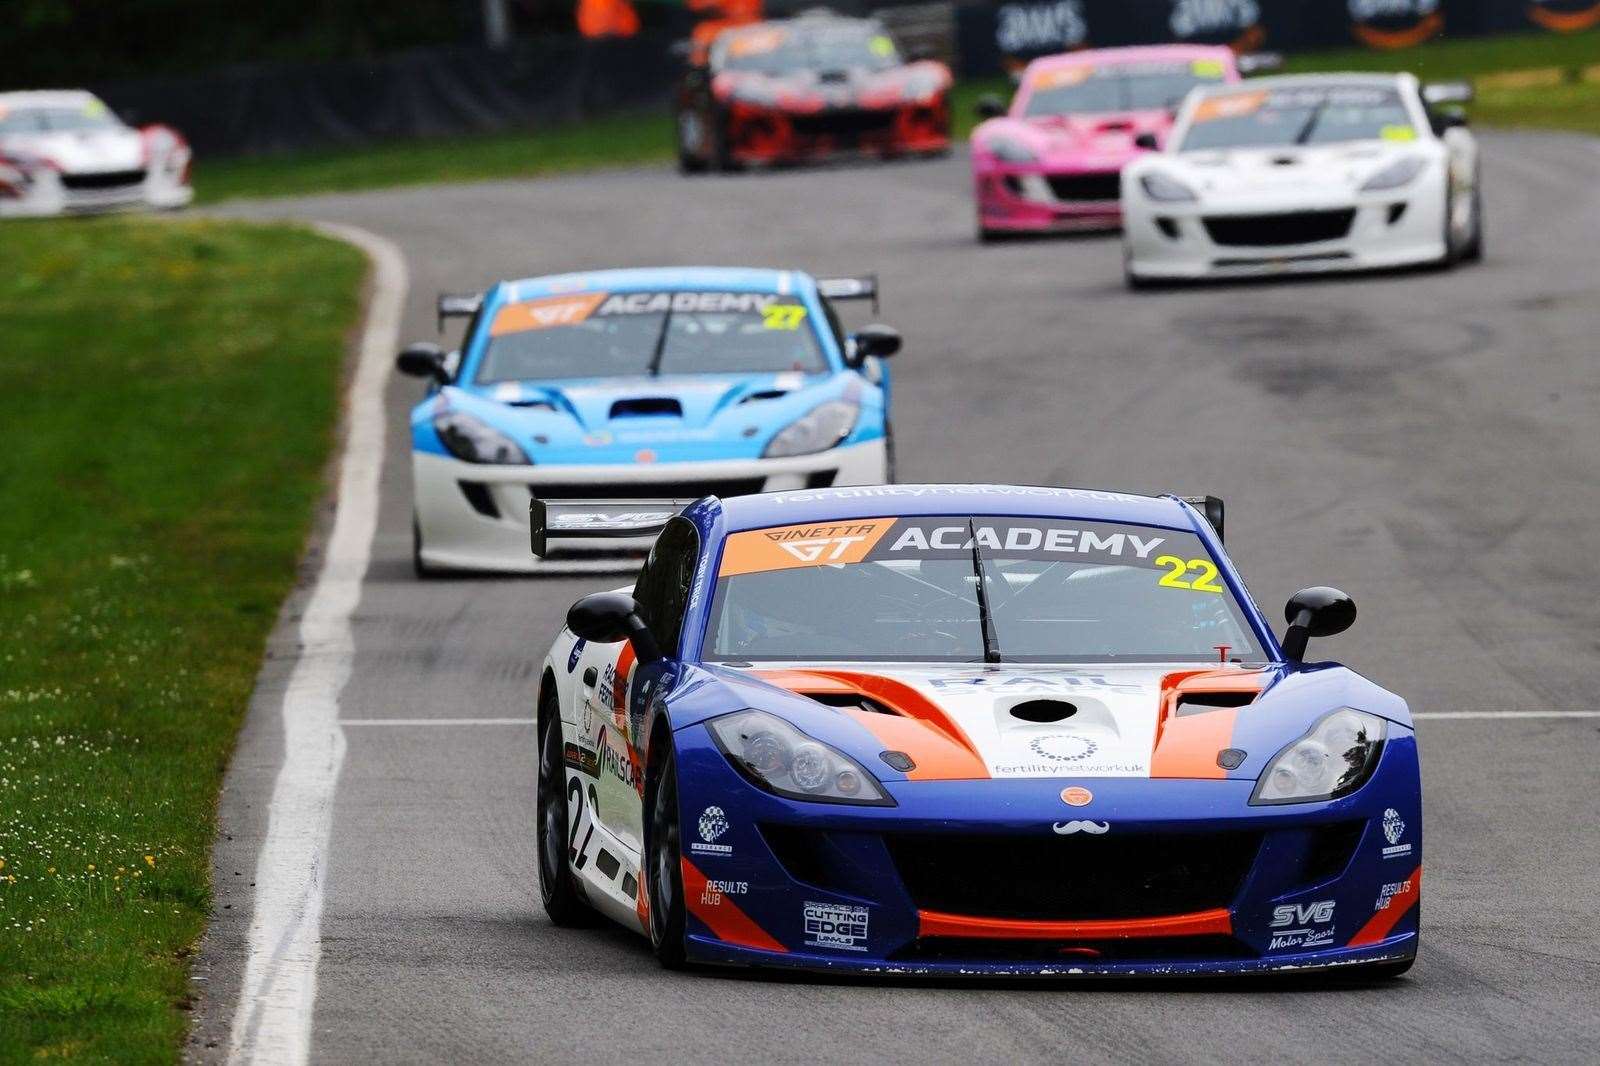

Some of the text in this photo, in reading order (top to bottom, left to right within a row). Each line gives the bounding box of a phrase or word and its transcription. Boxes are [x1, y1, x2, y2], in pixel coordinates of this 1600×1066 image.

[599, 293, 781, 315] ACADEMY
[759, 304, 808, 331] 27
[764, 524, 876, 542] GINETTA
[889, 526, 1166, 559] ACADEMY
[778, 535, 866, 562] GT
[1155, 555, 1225, 594] 22
[994, 763, 1145, 775] fertilitynetworkuk
[706, 879, 749, 894] RESULTS
[1380, 880, 1412, 897] RESULTS
[701, 892, 721, 905] HUB
[1375, 896, 1392, 911] HUB
[805, 909, 867, 923] CUTTING
[1269, 900, 1336, 928] SVG
[806, 919, 867, 938] EDGE
[1269, 925, 1336, 950] Motor Sport
